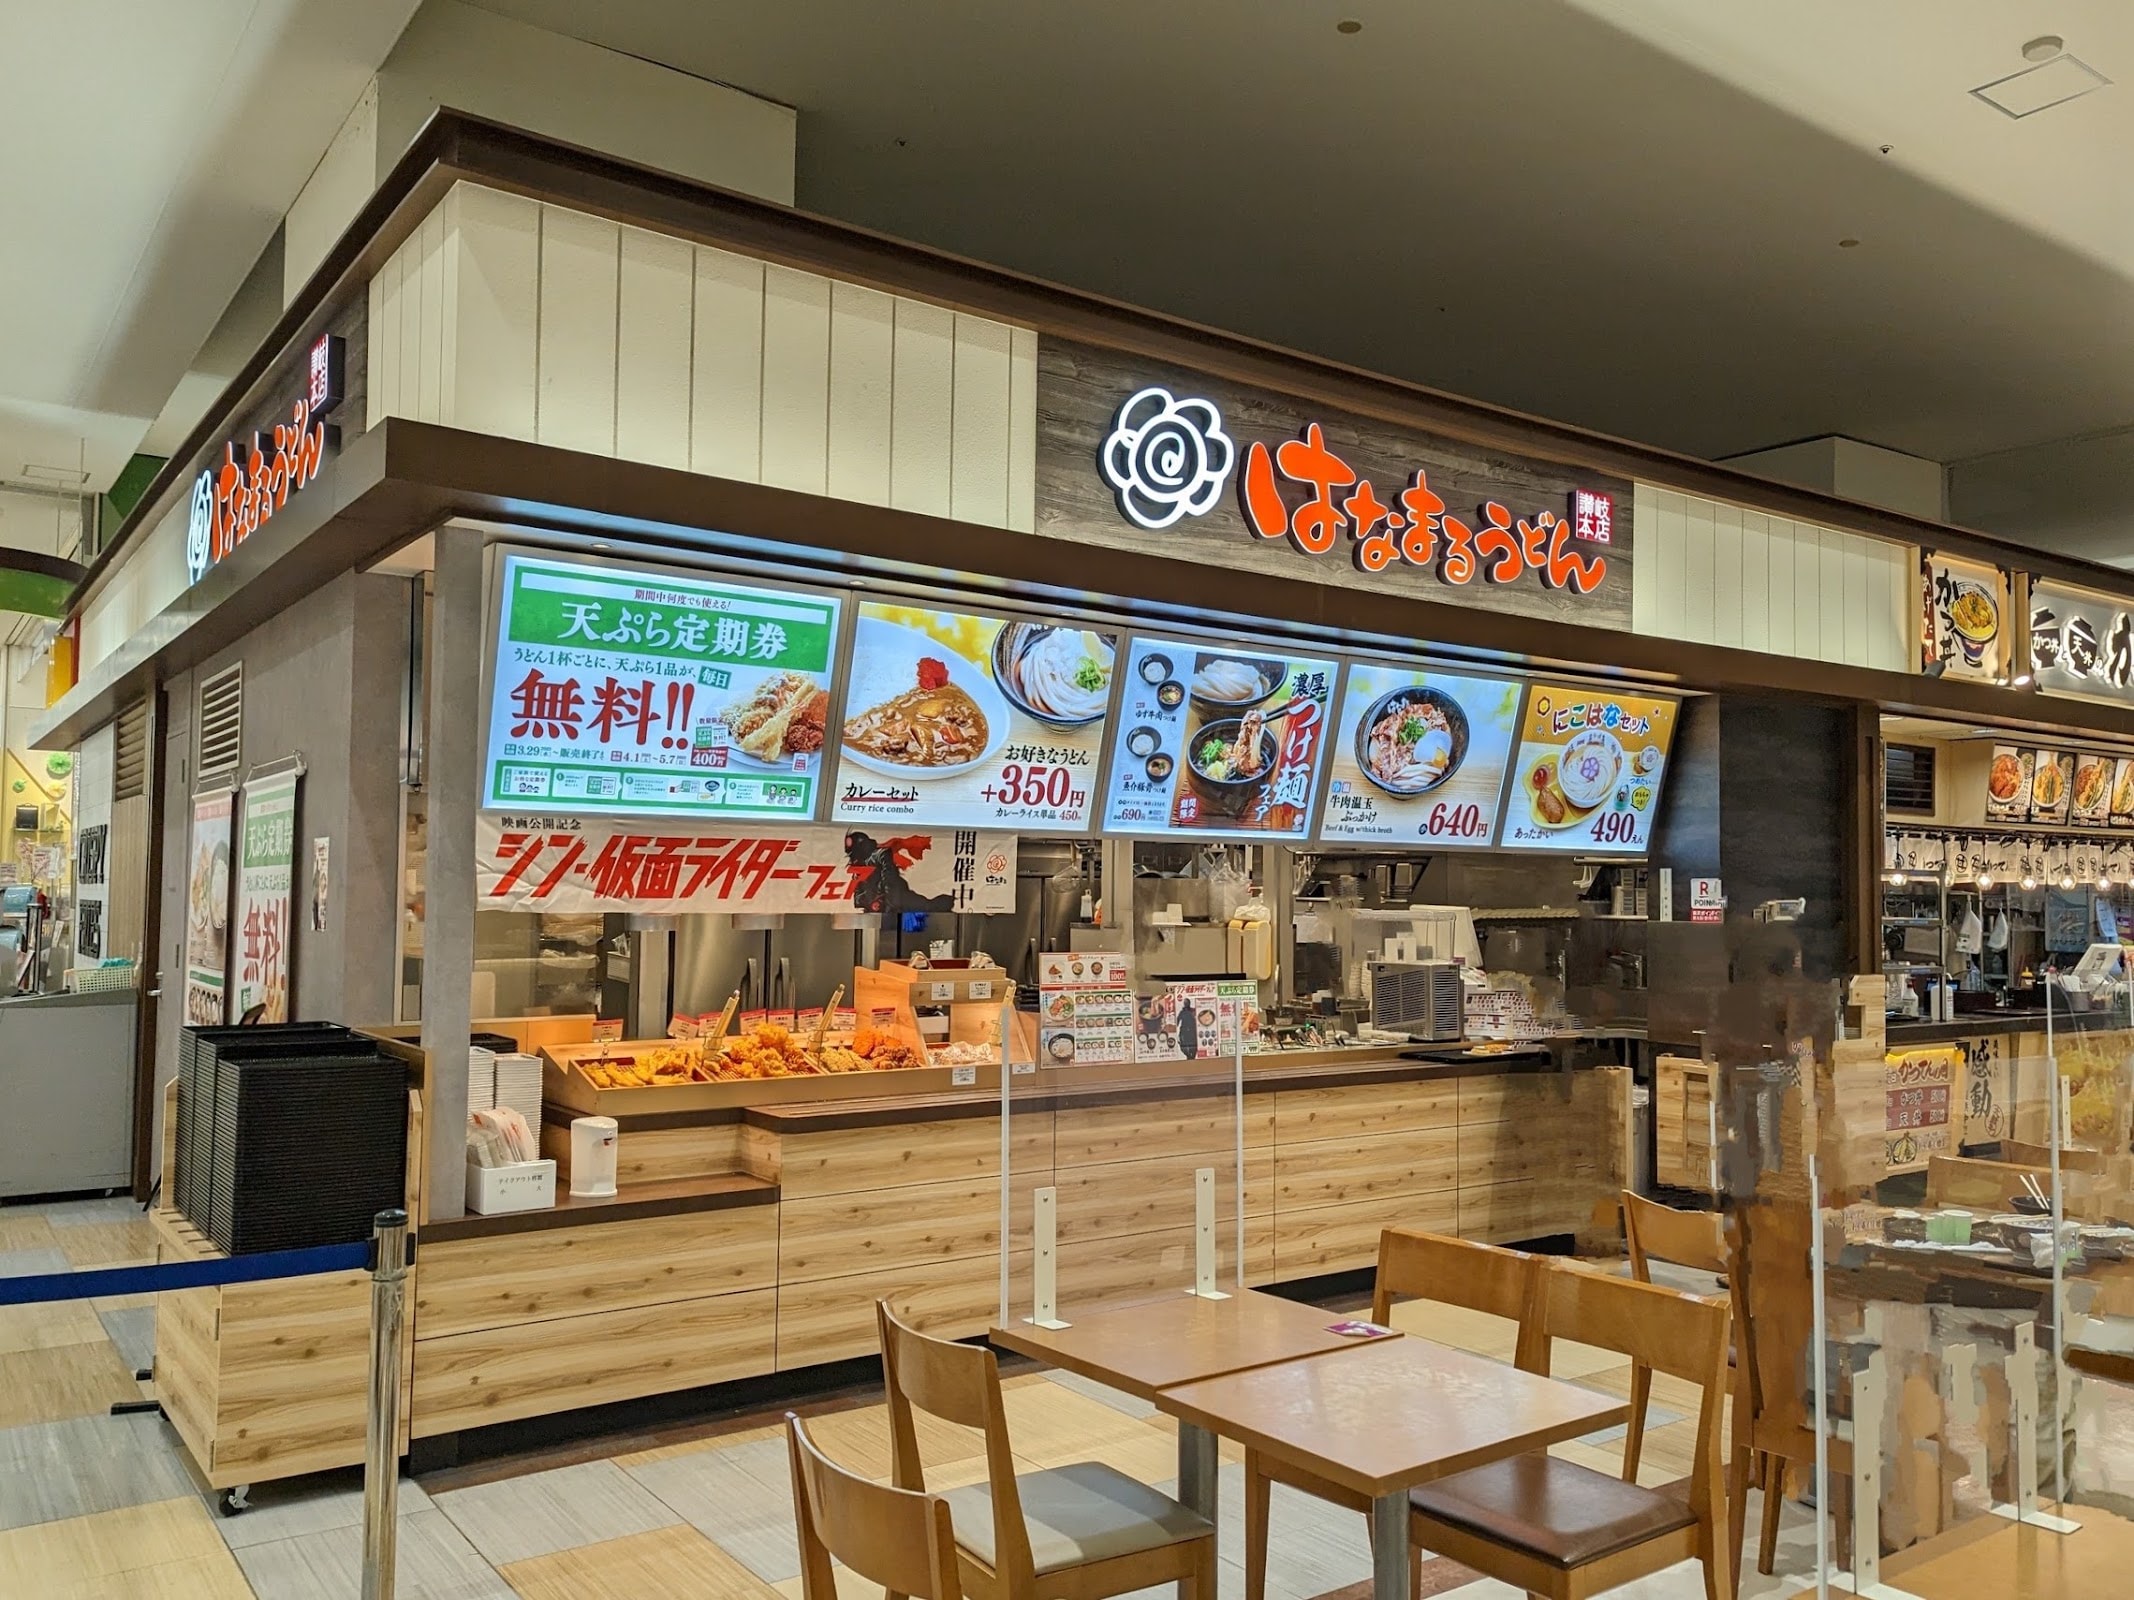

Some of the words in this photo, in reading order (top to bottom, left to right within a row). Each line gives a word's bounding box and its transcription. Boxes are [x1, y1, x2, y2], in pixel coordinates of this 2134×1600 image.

[212, 398, 324, 564] はなまるうどん
[1245, 422, 1607, 594] はなまるうどん
[1578, 492, 1611, 517] 讃岐
[1578, 516, 1611, 542] 本店
[634, 588, 732, 611] 期間中何度でも使える!
[557, 601, 789, 661] 天ぷら定期券
[1935, 568, 1960, 668] かつ丼
[702, 668, 729, 688] 毎日
[1291, 672, 1327, 699] 濃厚
[510, 668, 696, 750] 無料!!
[1552, 702, 1650, 737] にこはなセット
[1005, 744, 1090, 766] お好きなうどん
[1272, 698, 1322, 809] つけ麺
[845, 782, 919, 802] カレーセット
[1255, 783, 1273, 822] フェア
[1330, 794, 1374, 809] 牛肉温玉
[841, 802, 867, 813] Curry
[868, 804, 885, 813] rice
[886, 804, 914, 813] combo
[995, 807, 1057, 820] カレーライス単品
[1340, 810, 1377, 824] ぶっかけ
[1428, 802, 1488, 838] 640円
[501, 816, 582, 831] 映画公開記念
[1344, 825, 1355, 833] Egg
[1513, 827, 1554, 840] あったかい
[952, 830, 977, 910] 開催中
[1970, 1038, 1993, 1119] 感動
